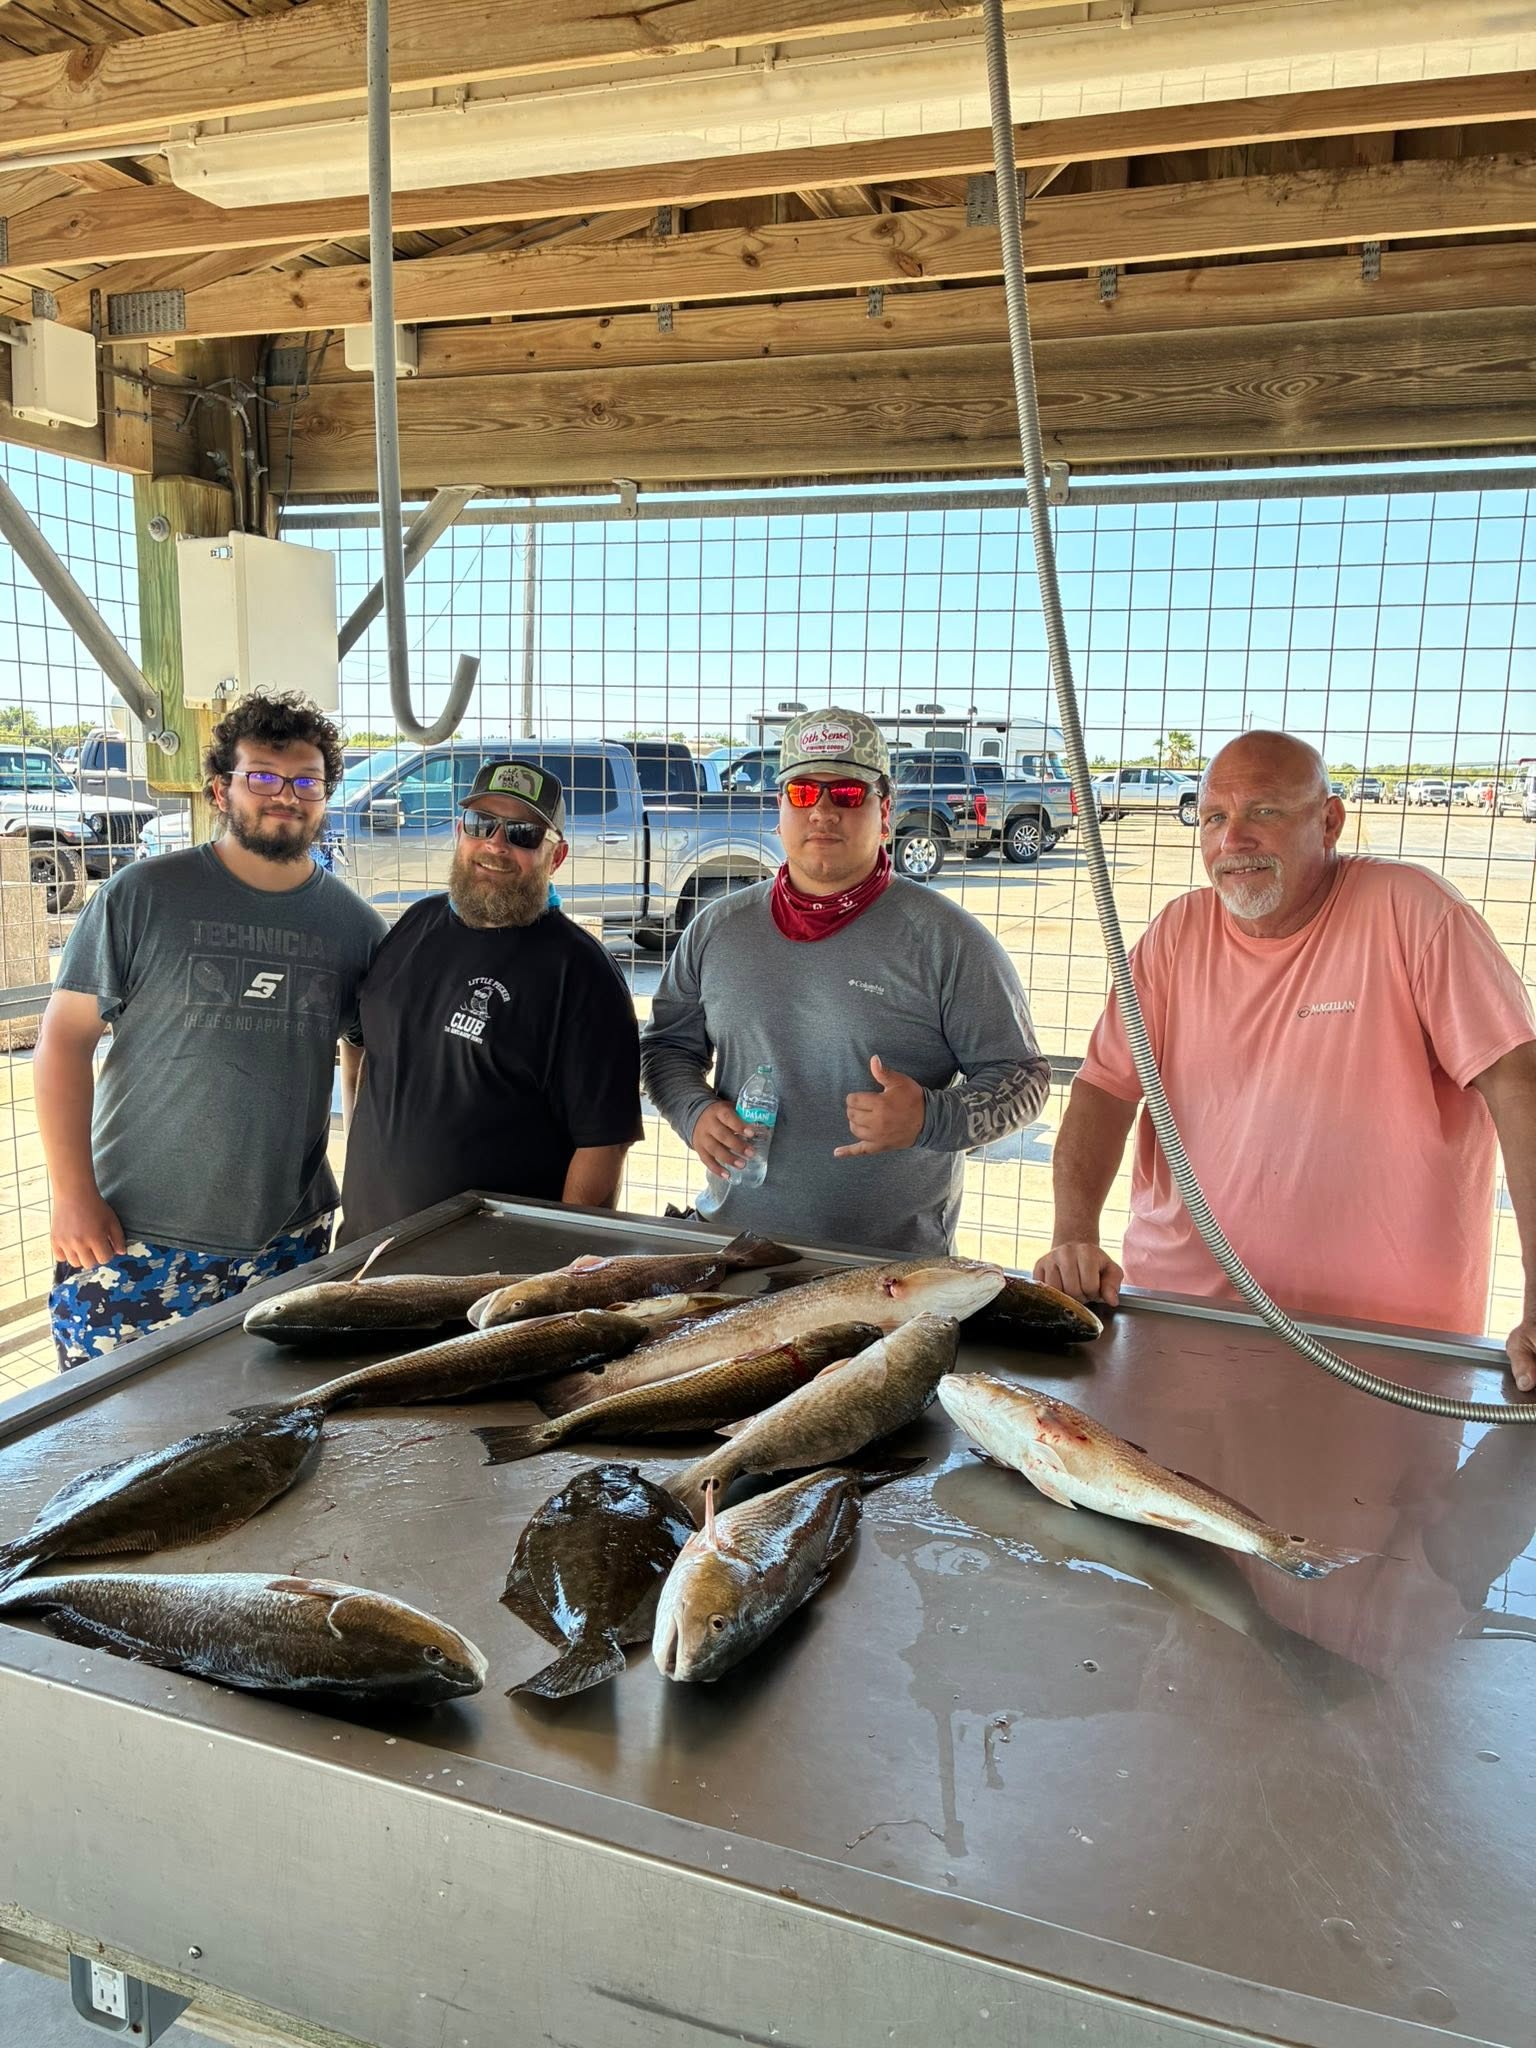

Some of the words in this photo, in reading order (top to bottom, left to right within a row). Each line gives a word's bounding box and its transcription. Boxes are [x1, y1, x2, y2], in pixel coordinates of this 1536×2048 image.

[802, 731, 818, 744] 6th
[821, 729, 849, 741] Sense
[192, 920, 328, 959] TECHNICIA
[468, 976, 494, 986] LITTLE
[1311, 1000, 1355, 1012] MAGELLAN
[183, 1011, 232, 1031] THERE'S
[235, 1015, 253, 1032] NO
[283, 1019, 306, 1038] FR
[450, 1012, 486, 1036] CLUB
[745, 1109, 770, 1122] DASANI
